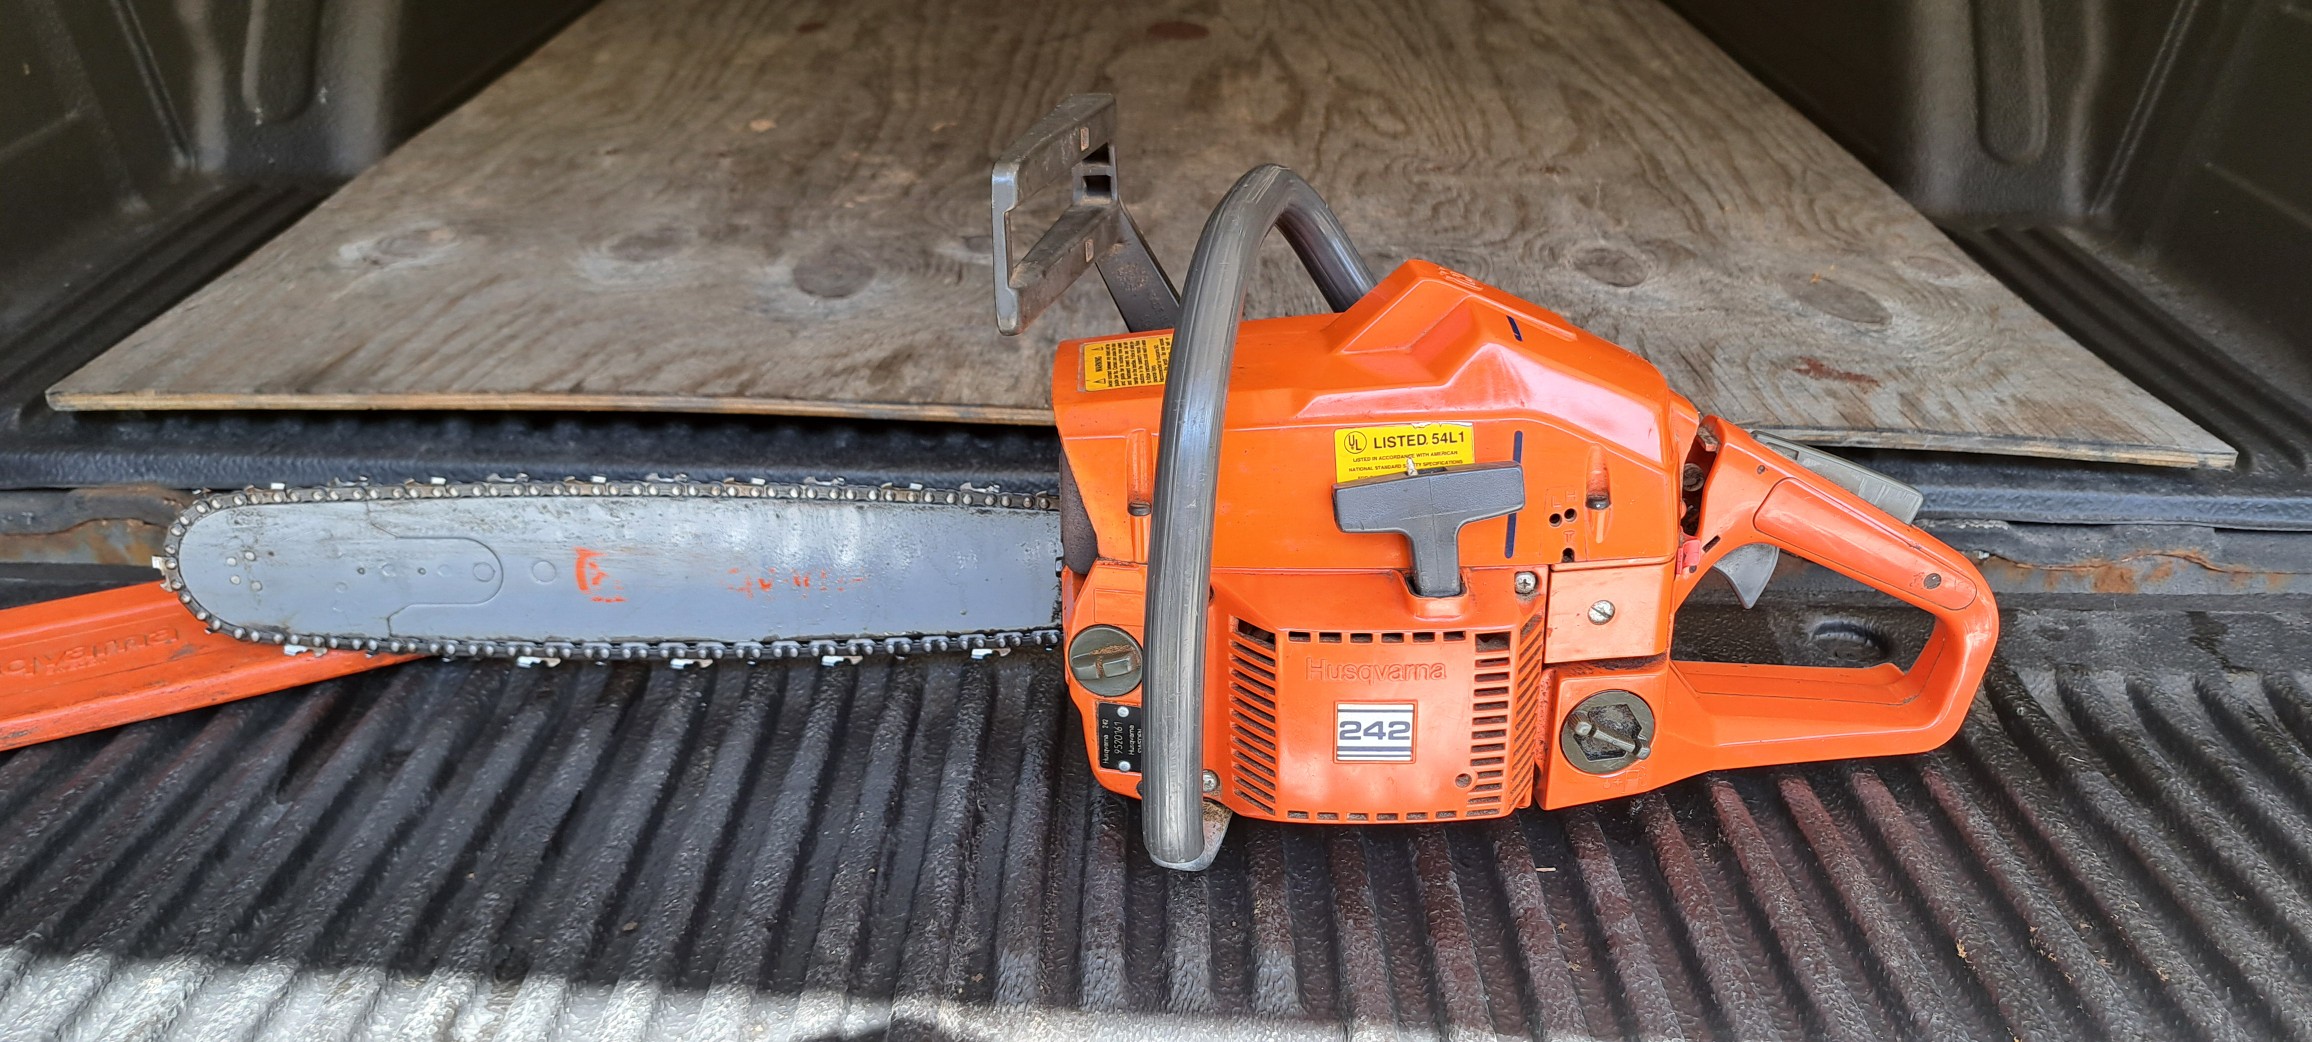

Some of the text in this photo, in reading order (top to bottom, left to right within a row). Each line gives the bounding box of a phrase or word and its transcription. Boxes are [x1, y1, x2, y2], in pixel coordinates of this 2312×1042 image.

[1431, 431, 1464, 445] 54L1
[1375, 463, 1402, 471] STANDARD
[1423, 459, 1463, 467] SPECIFICATIONS
[1379, 453, 1415, 461] ACCORDANCE
[1305, 657, 1447, 686] Husqvarna
[1113, 721, 1124, 754] 9520161
[1128, 724, 1136, 756] Husqvarna
[1339, 720, 1411, 740] 242
[1102, 735, 1110, 764] Husqvarna
